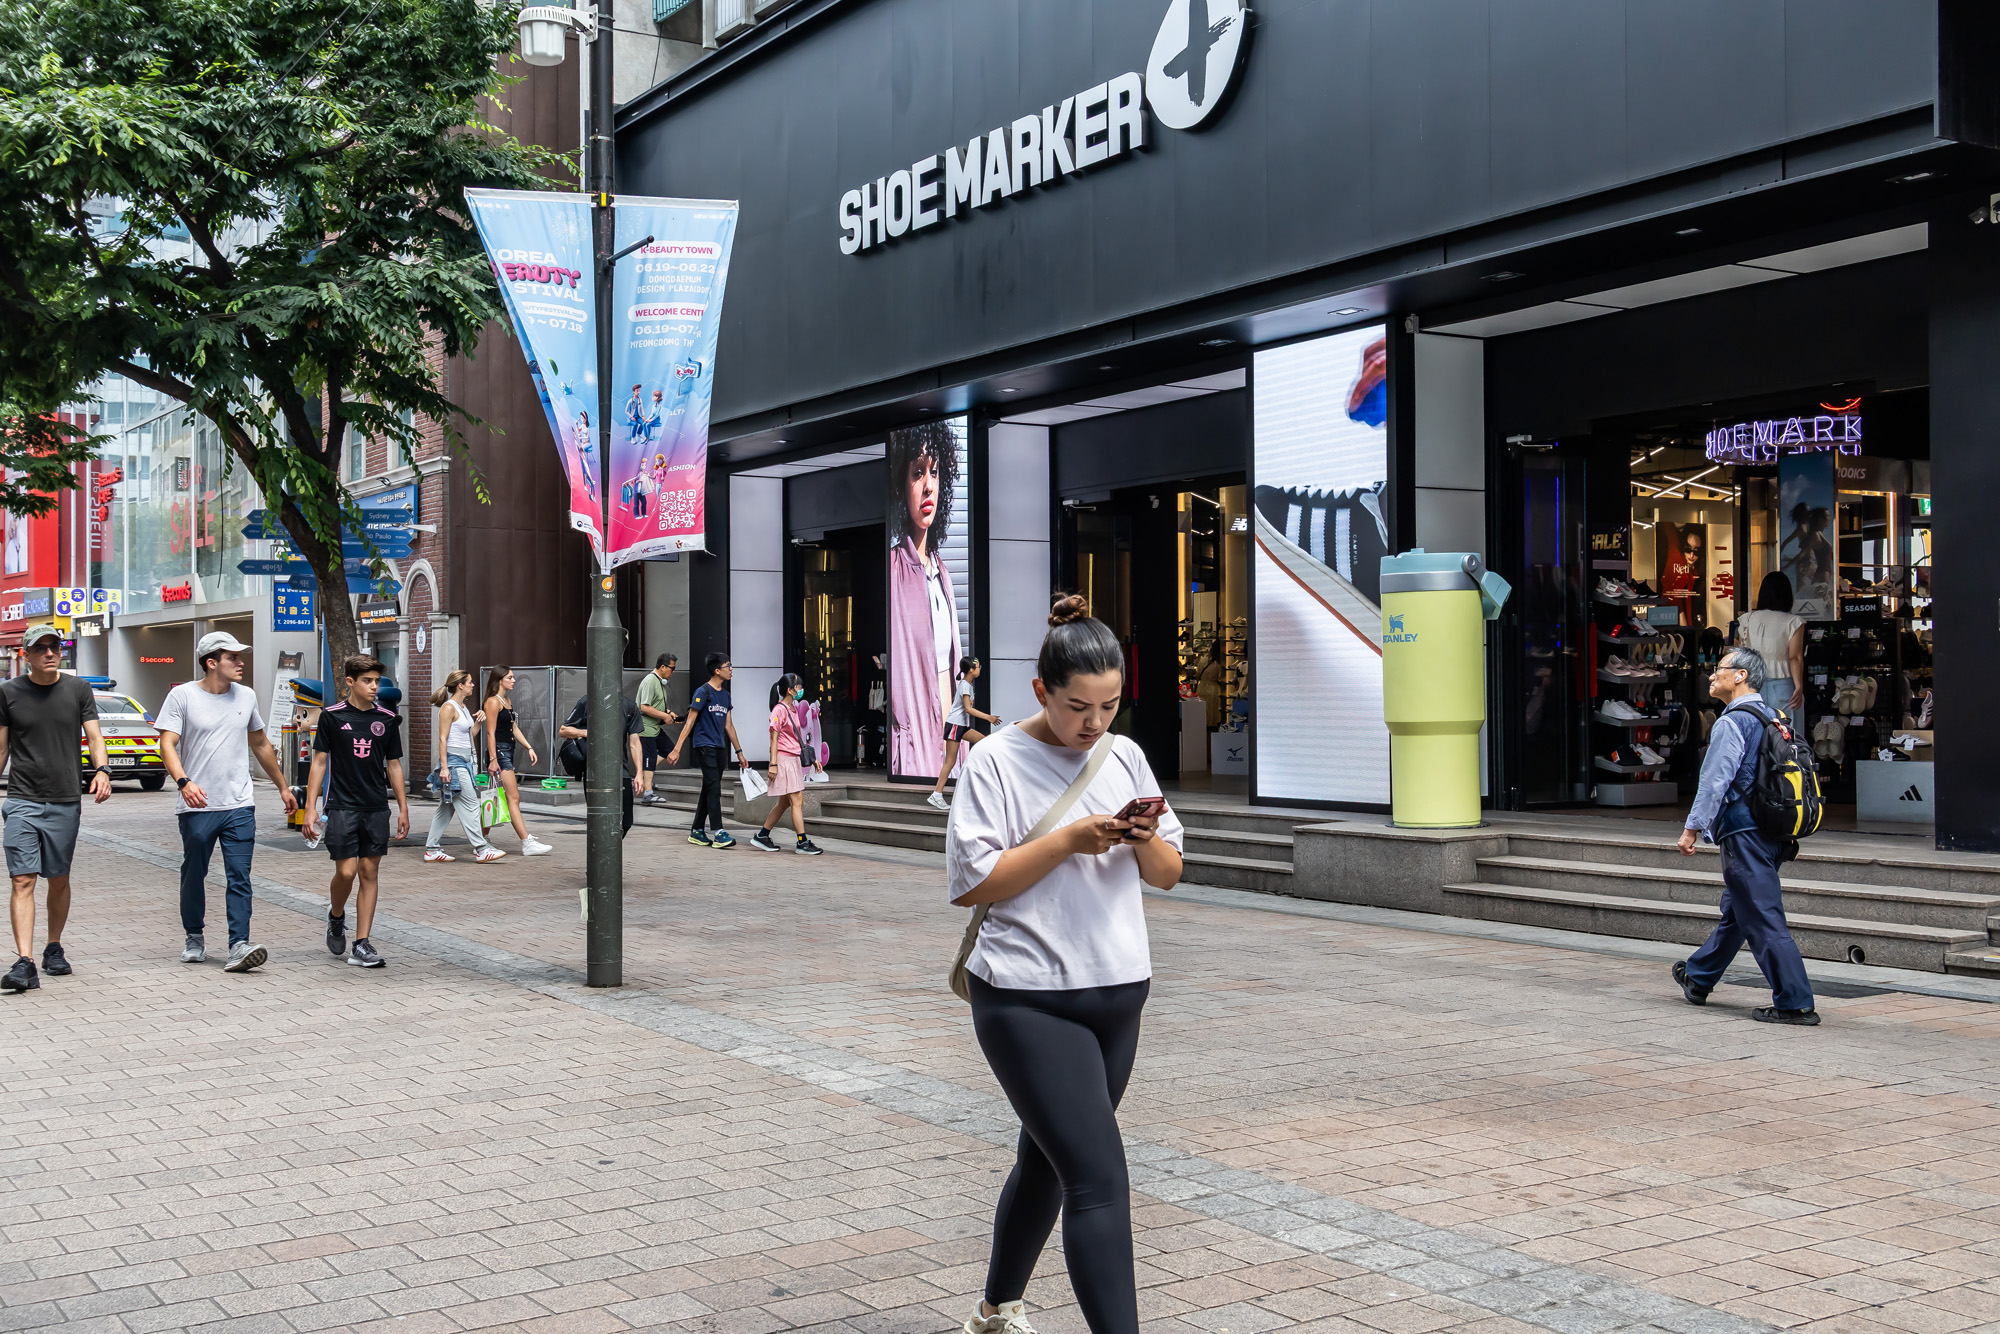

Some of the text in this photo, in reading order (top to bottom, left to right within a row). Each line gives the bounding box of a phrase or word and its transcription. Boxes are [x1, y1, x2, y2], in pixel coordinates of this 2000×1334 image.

[640, 246, 713, 255] K-BEAUTY TOWN
[494, 249, 558, 266] OREA
[635, 262, 716, 274] 06.19~06.22
[648, 275, 702, 284] DONGDAEMUN
[637, 285, 665, 294] DESIGN
[635, 308, 678, 317] WELCOME
[635, 324, 699, 335] 06.19~07.
[630, 338, 680, 349] MYEONGDONG
[368, 513, 390, 521] Sydney
[170, 490, 214, 554] SALE
[1845, 604, 1876, 612] SEASON
[1383, 633, 1418, 643] STANLEY
